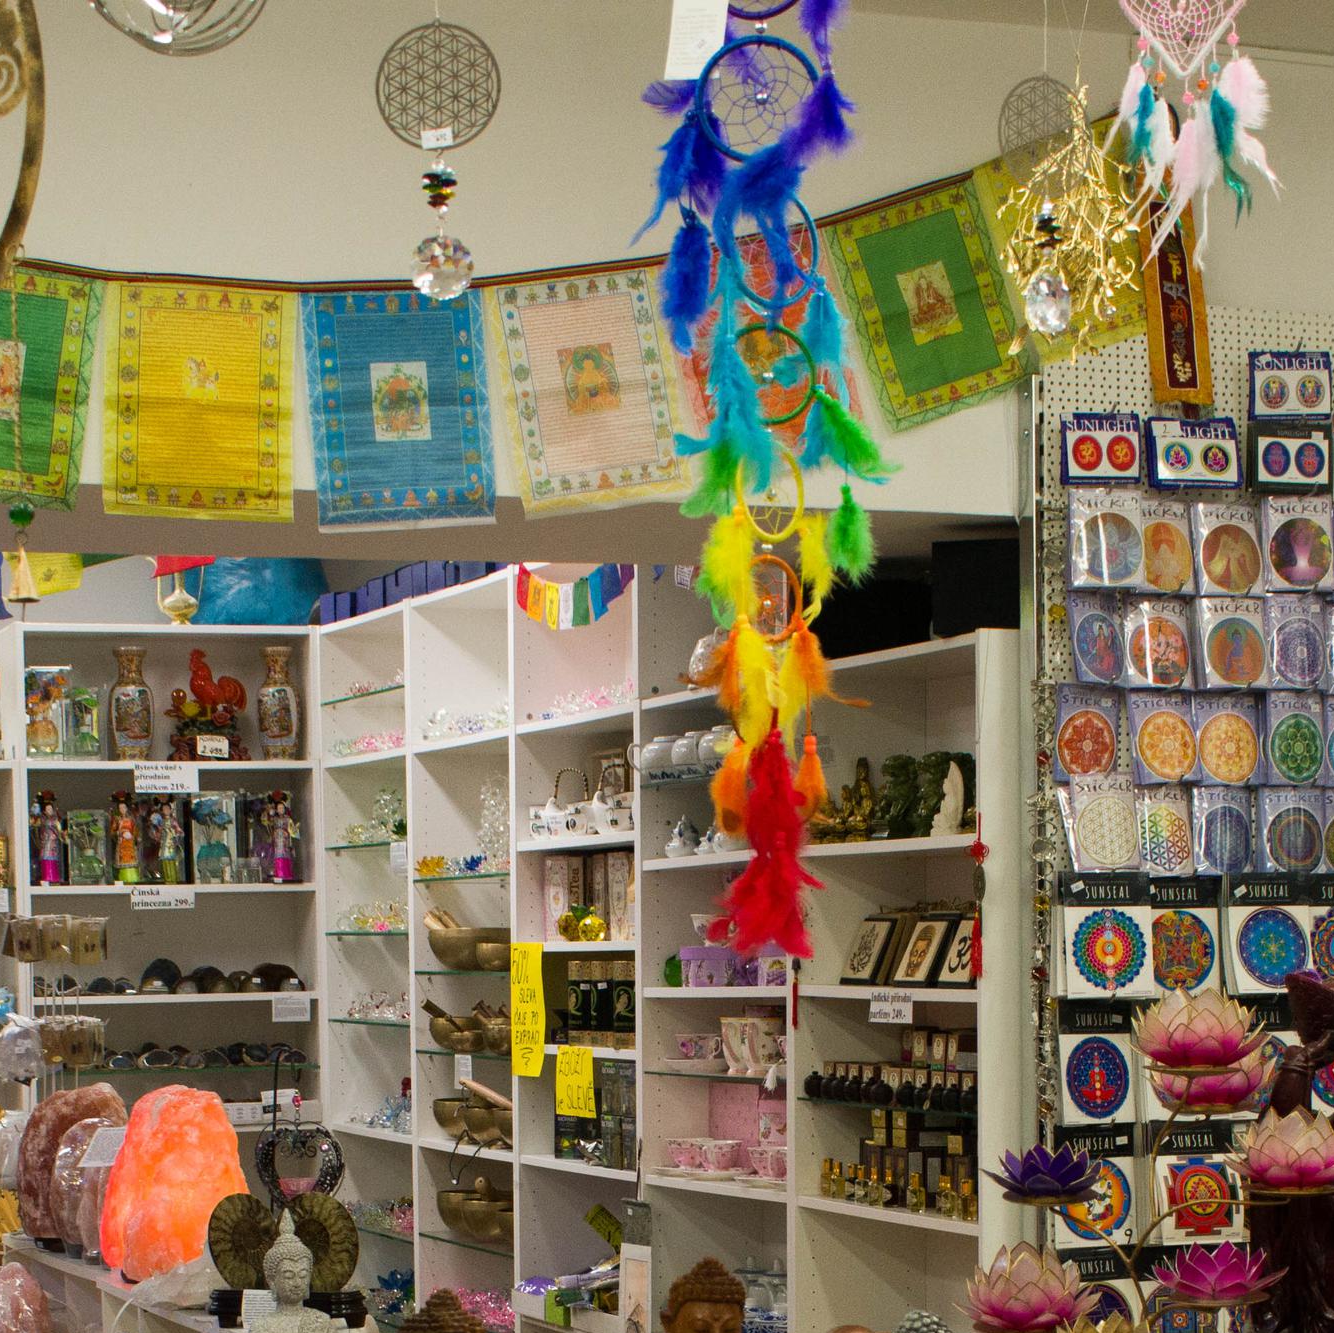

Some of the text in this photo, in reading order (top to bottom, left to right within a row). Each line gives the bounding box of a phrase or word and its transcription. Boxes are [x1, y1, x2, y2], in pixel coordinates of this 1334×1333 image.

[1255, 357, 1326, 371] SUNLIGHT
[1066, 419, 1136, 433] SUNLIGHT
[1075, 780, 1132, 794] STICKER
[1085, 885, 1129, 899] SUNSEAL
[1156, 887, 1197, 901] SUNSEAL
[1249, 884, 1288, 898] SUNSEAL
[1073, 1138, 1114, 1150] SUNSEAL
[1172, 1134, 1214, 1149] SUNSEAL
